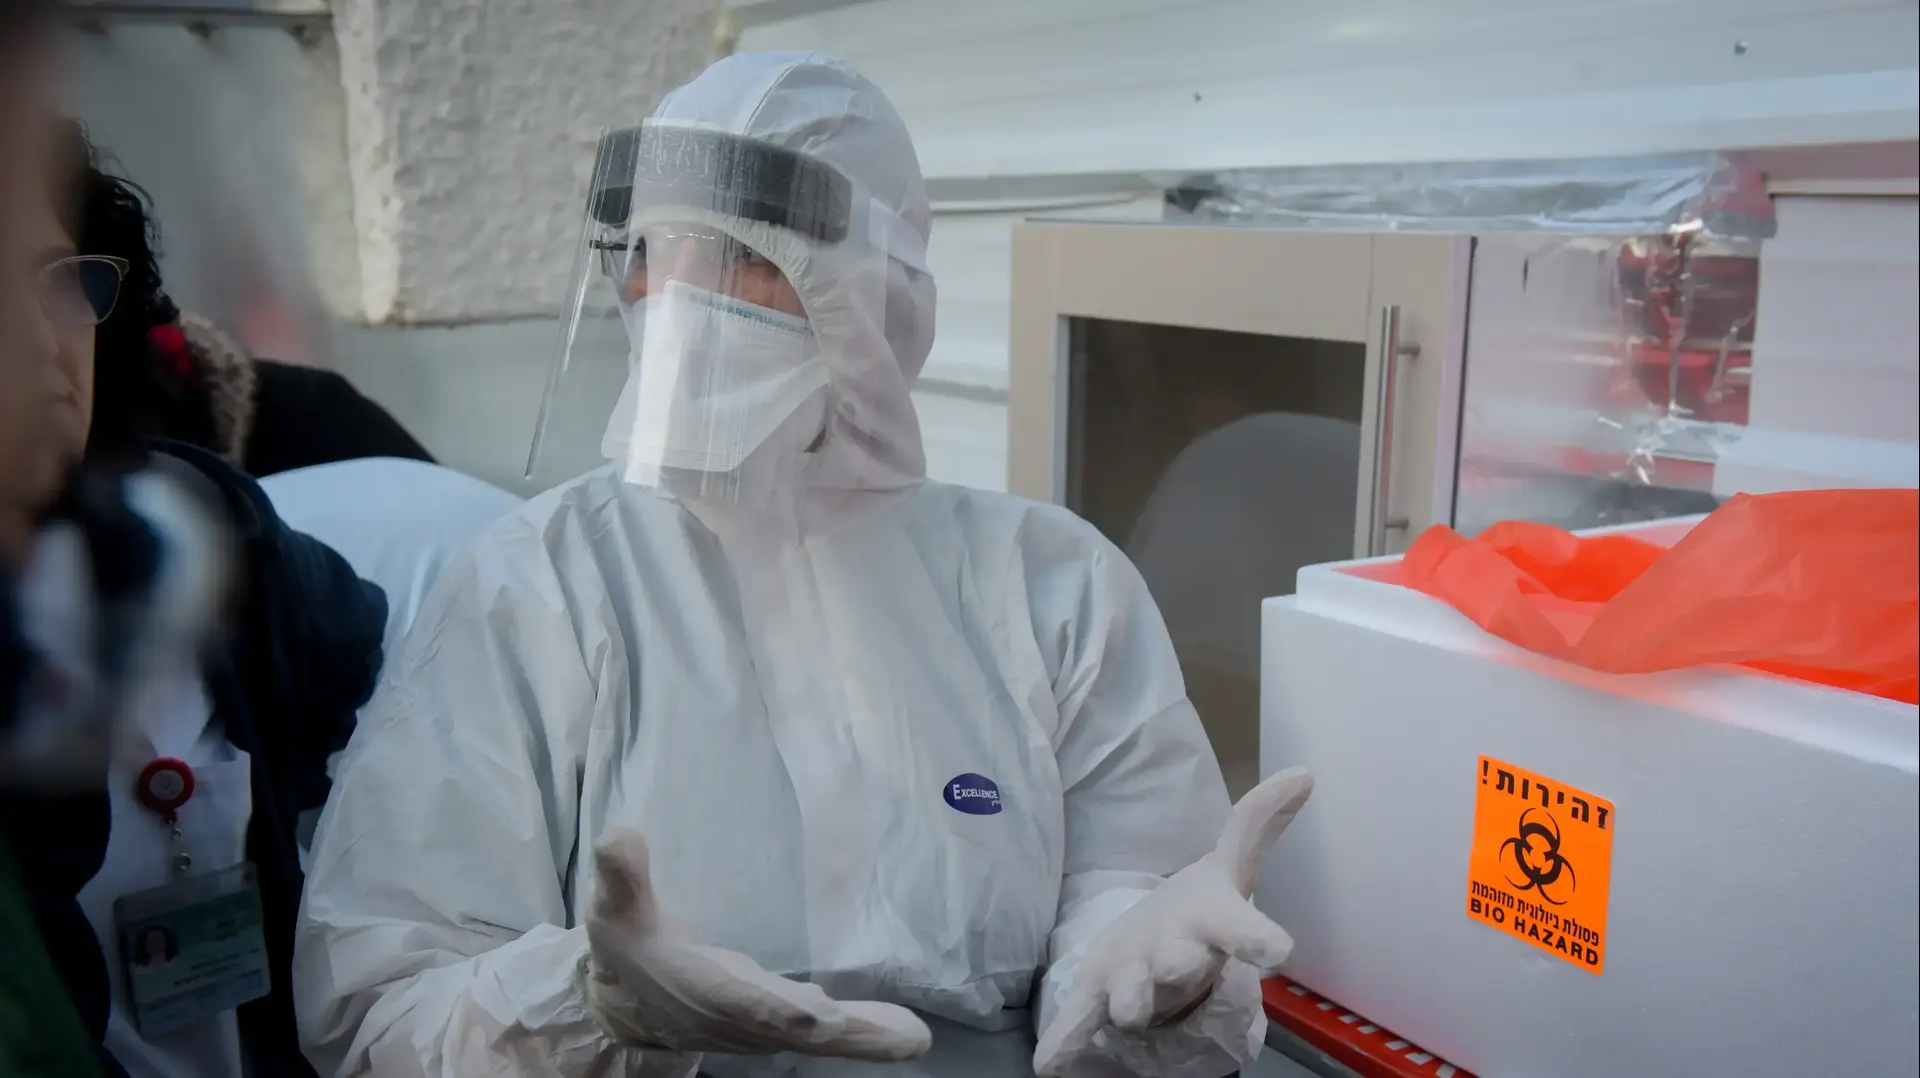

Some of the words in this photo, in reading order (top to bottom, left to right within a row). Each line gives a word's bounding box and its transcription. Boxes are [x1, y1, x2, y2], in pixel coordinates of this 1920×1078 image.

[1472, 880, 1514, 909] מזוהמת
[1517, 898, 1559, 930] ביולוגית
[1470, 897, 1505, 923] BIO
[1514, 916, 1598, 966] HAZARD
[1563, 918, 1599, 947] פסולת
